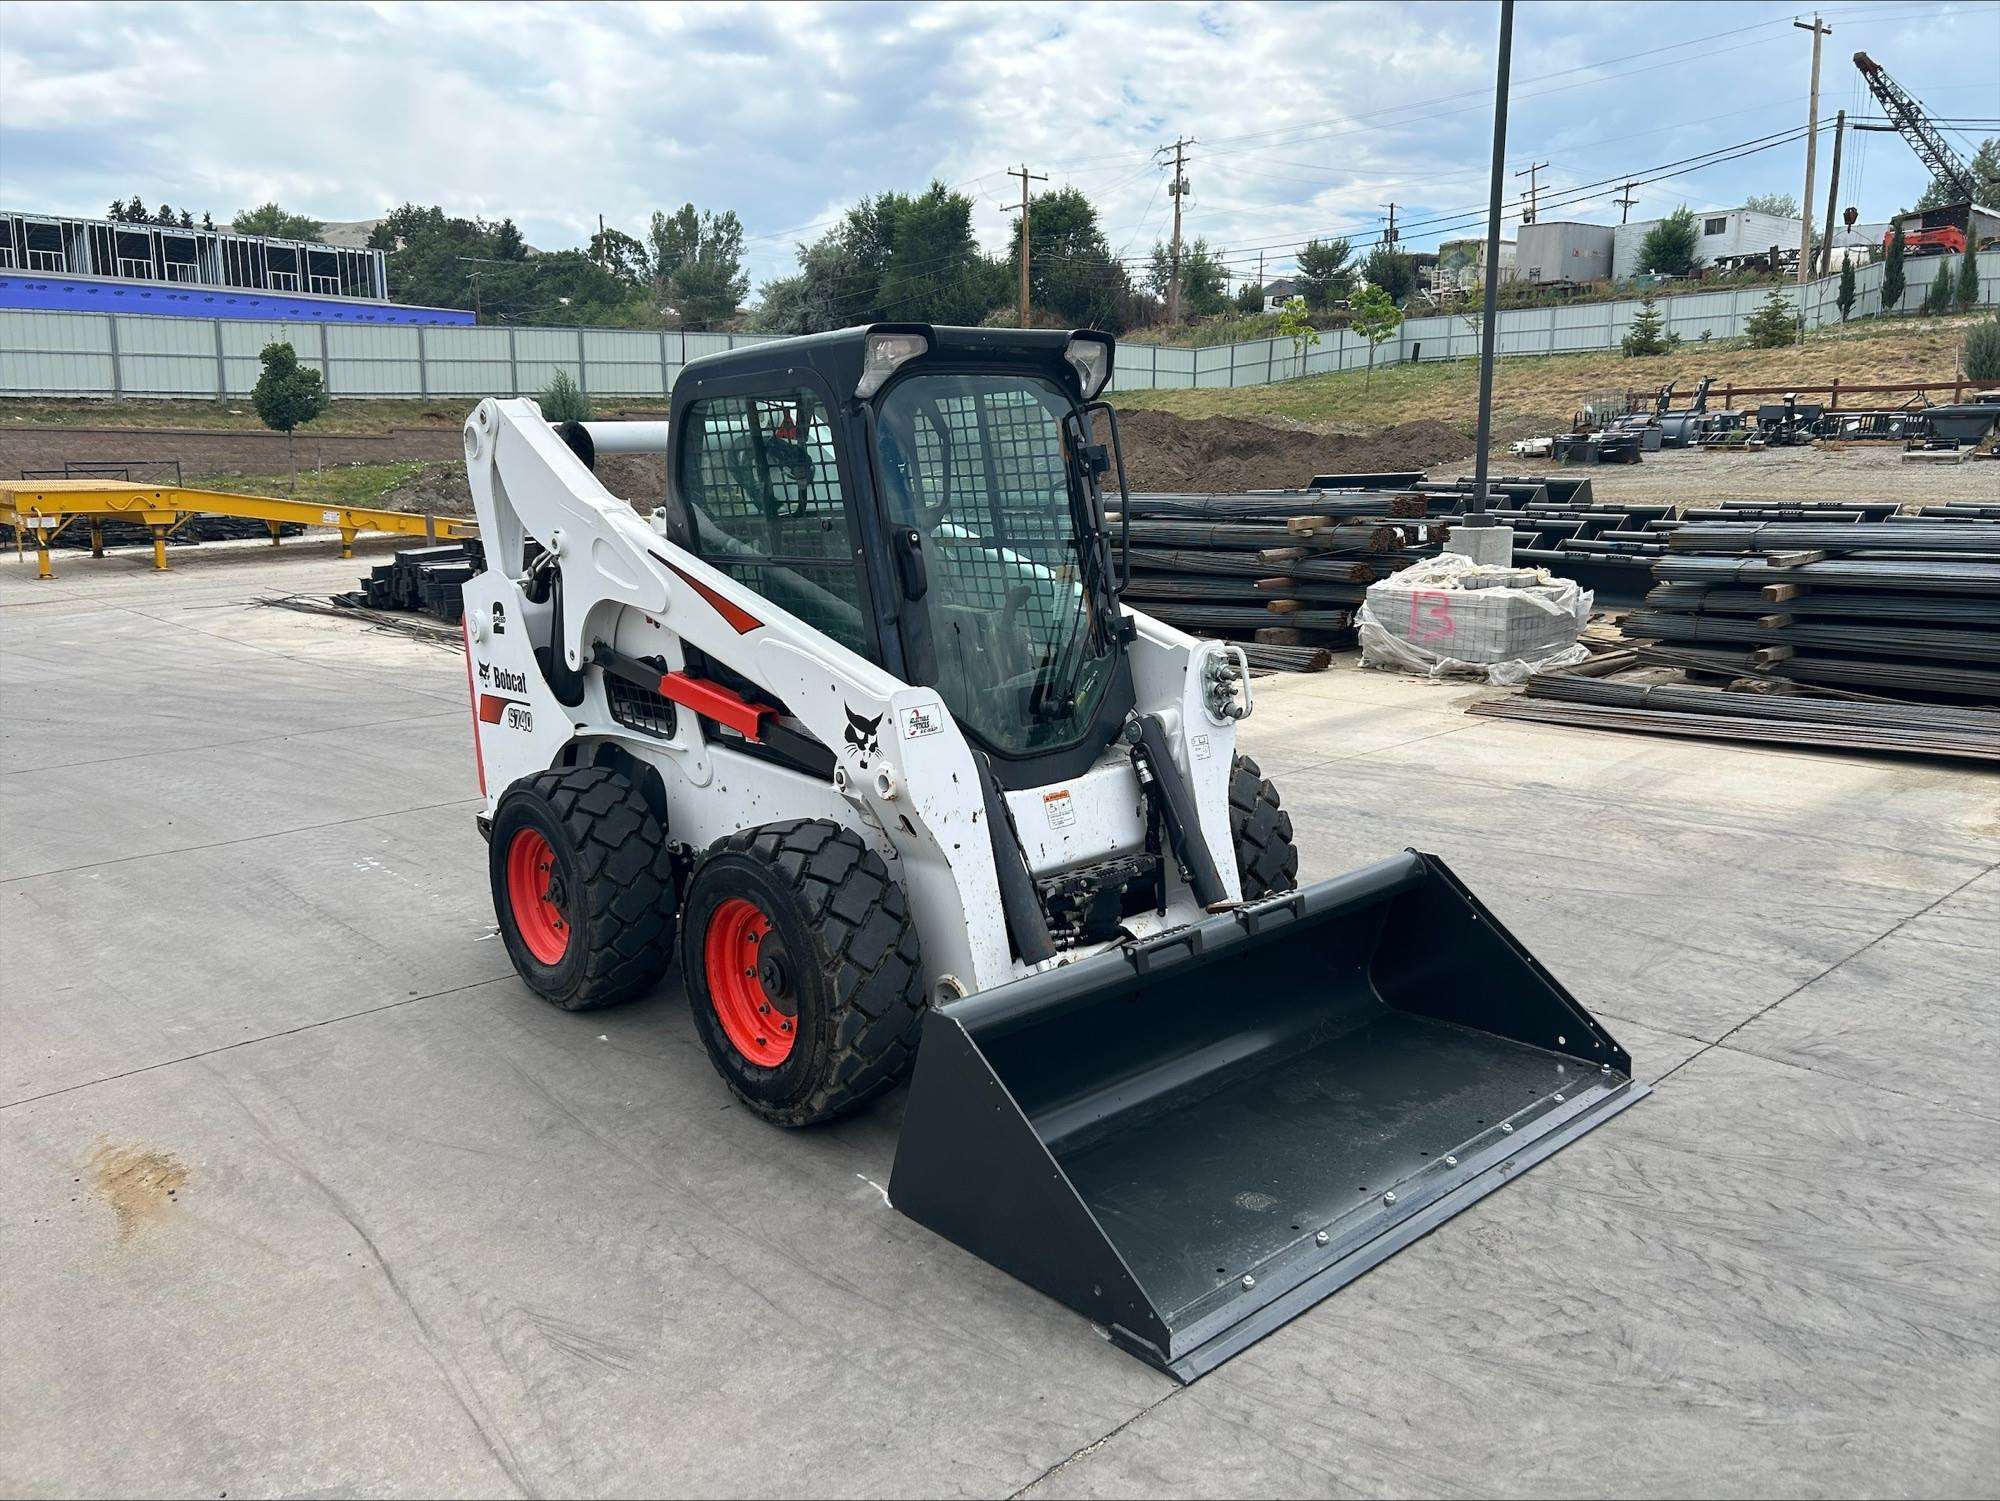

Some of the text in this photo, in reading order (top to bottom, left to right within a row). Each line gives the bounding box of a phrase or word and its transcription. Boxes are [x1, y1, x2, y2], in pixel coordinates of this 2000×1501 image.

[492, 601, 505, 635] 2
[493, 615, 506, 623] SPEED
[1408, 590, 1456, 641] 13
[493, 666, 527, 694] Bobcat
[508, 708, 533, 733] S740
